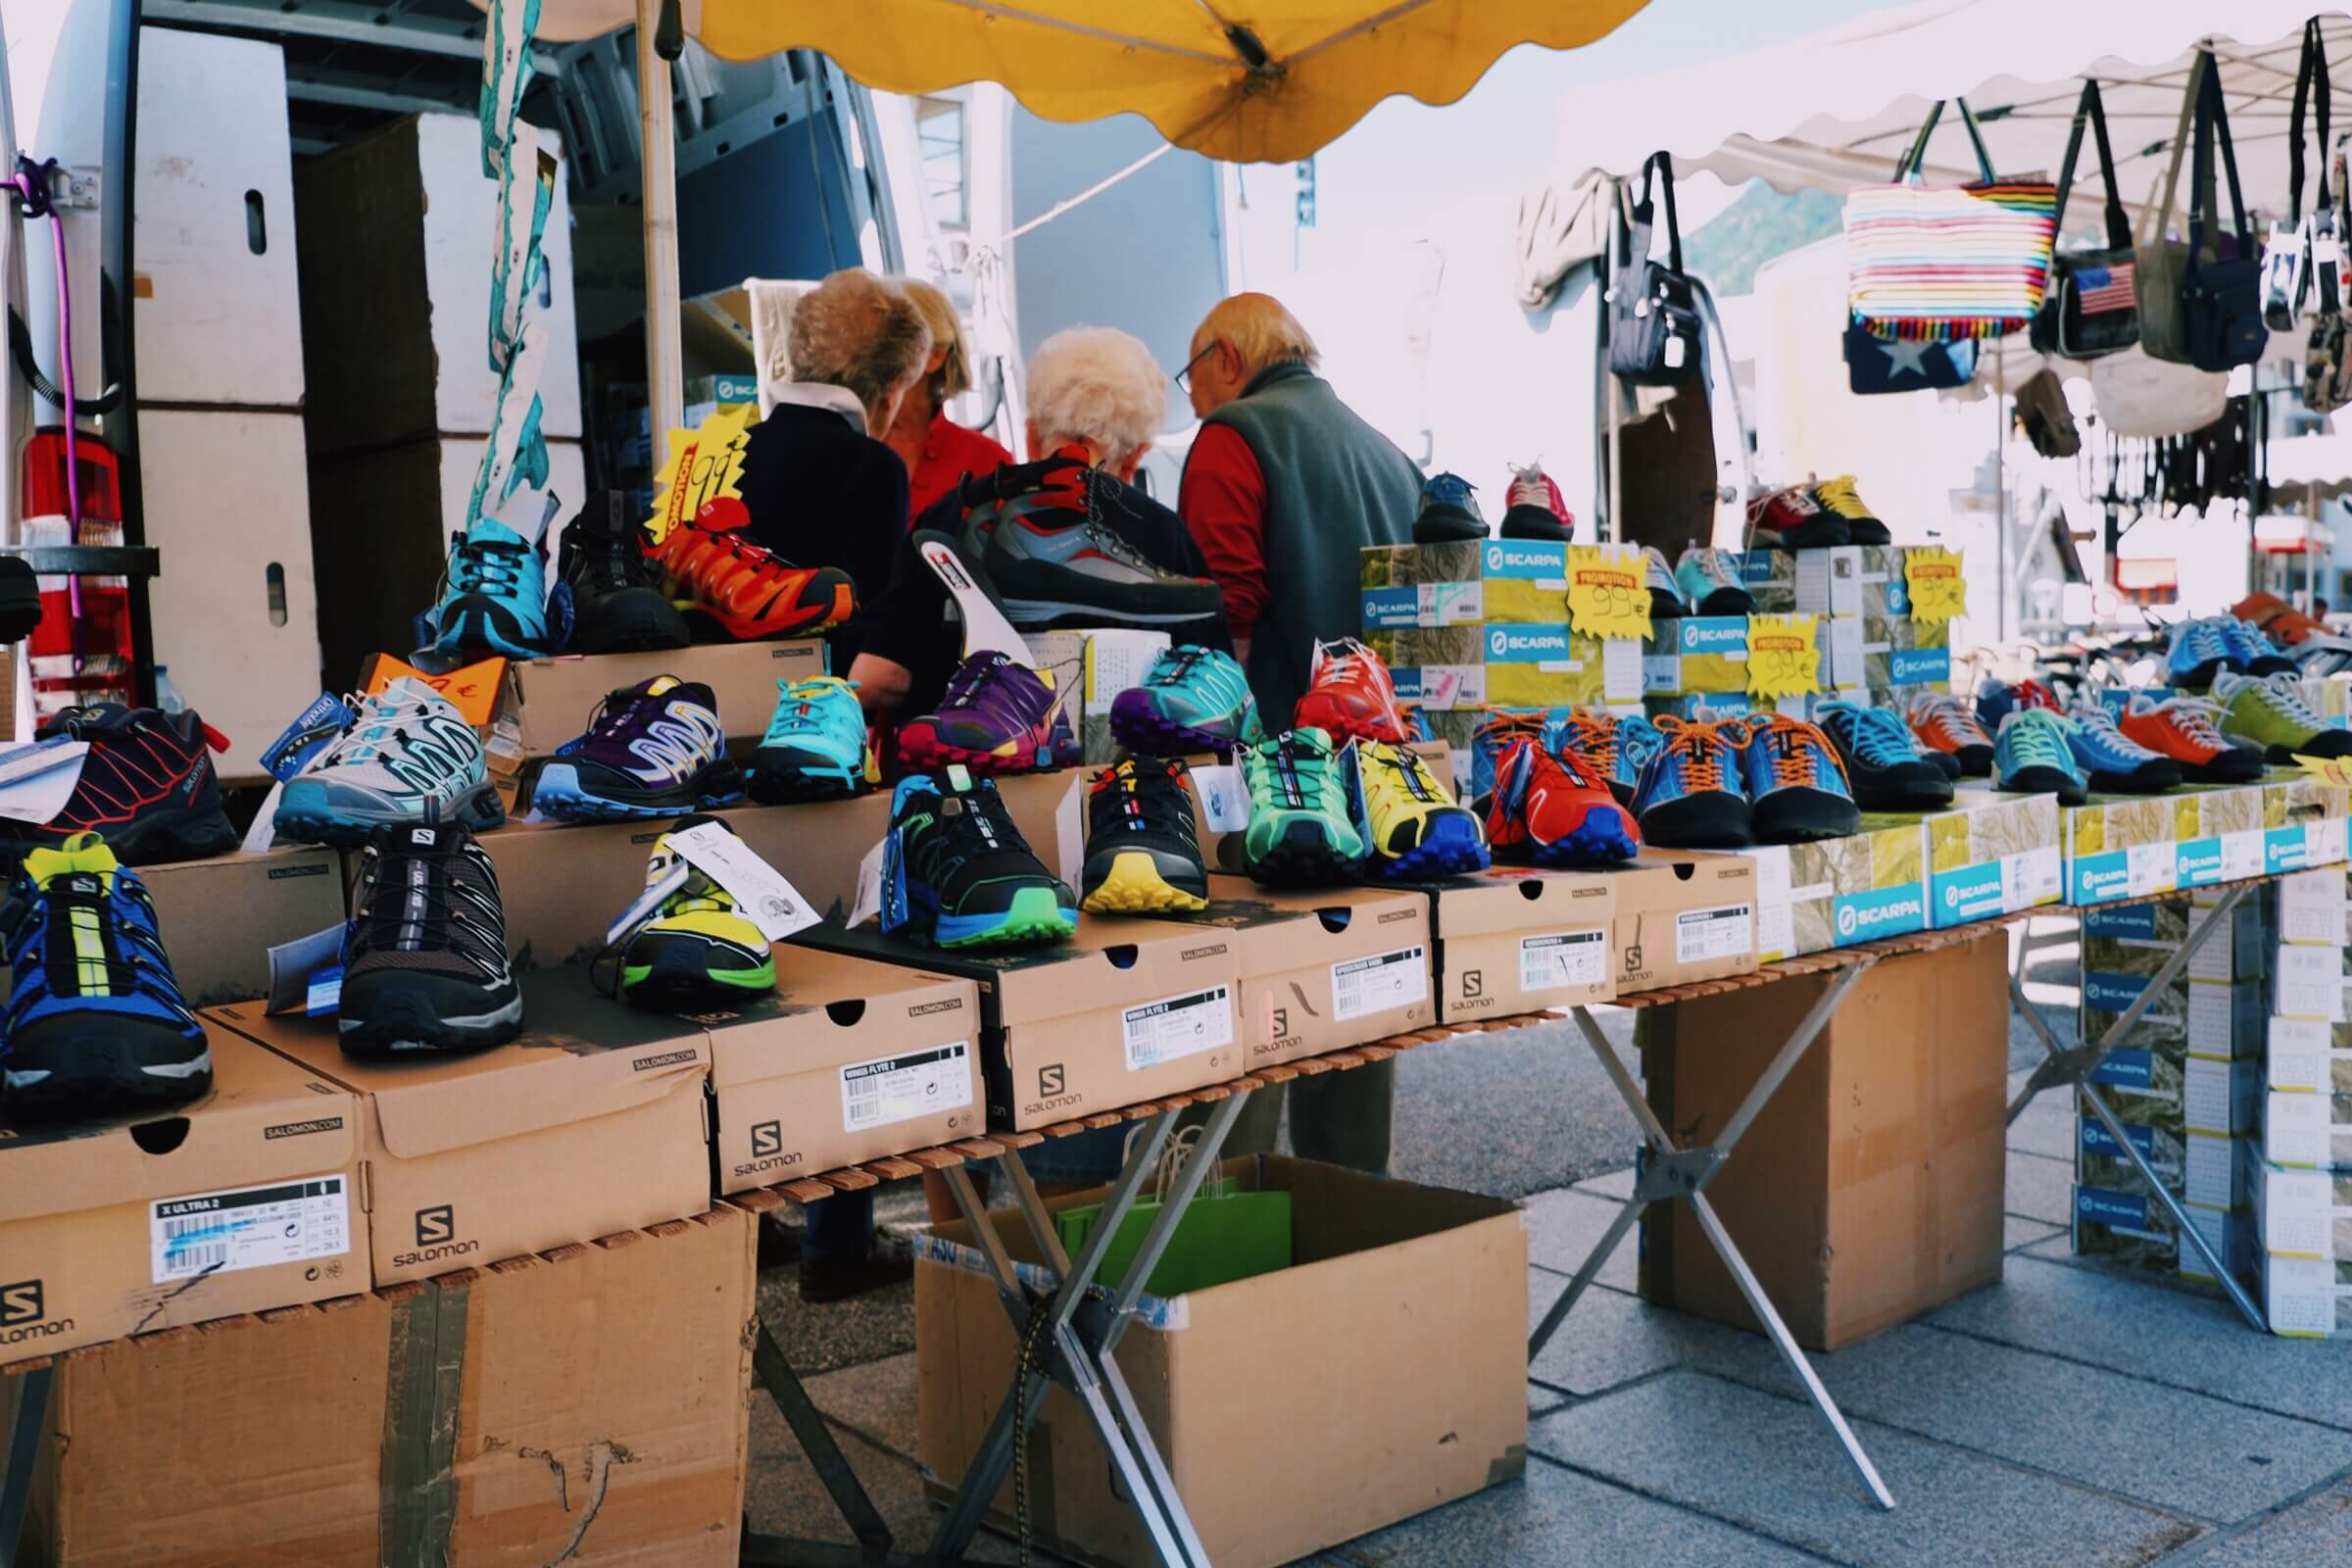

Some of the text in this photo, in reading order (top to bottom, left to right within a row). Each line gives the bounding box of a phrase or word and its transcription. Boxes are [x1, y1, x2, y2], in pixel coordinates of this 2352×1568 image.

[666, 454, 694, 536] OMOTION
[1505, 554, 1562, 567] SCARPA
[1579, 570, 1635, 587] PROMOTION
[1377, 603, 1416, 614] SCARPA
[1699, 627, 1746, 641] SCARPA
[1508, 636, 1566, 650] SCARPA
[1902, 659, 1946, 673] SCARPA
[2092, 869, 2128, 884] SCARPA
[1958, 881, 2001, 900] SCARPA
[1858, 900, 1922, 925] SCARPA
[2101, 914, 2152, 927] SCARPA
[910, 999, 962, 1016] SALOMON.COM
[1450, 996, 1494, 1011] salomon
[1253, 1035, 1302, 1055] salomon
[634, 1050, 696, 1070] SALOMON.COM
[1024, 1093, 1082, 1115] salomon
[266, 1118, 342, 1139] SALOMON.COM
[735, 1152, 803, 1176] salomon
[162, 1200, 220, 1215] X ULTRA 2
[2094, 1202, 2143, 1217] SCARPA
[393, 1239, 478, 1267] salomon
[0, 1318, 74, 1345] lomon
